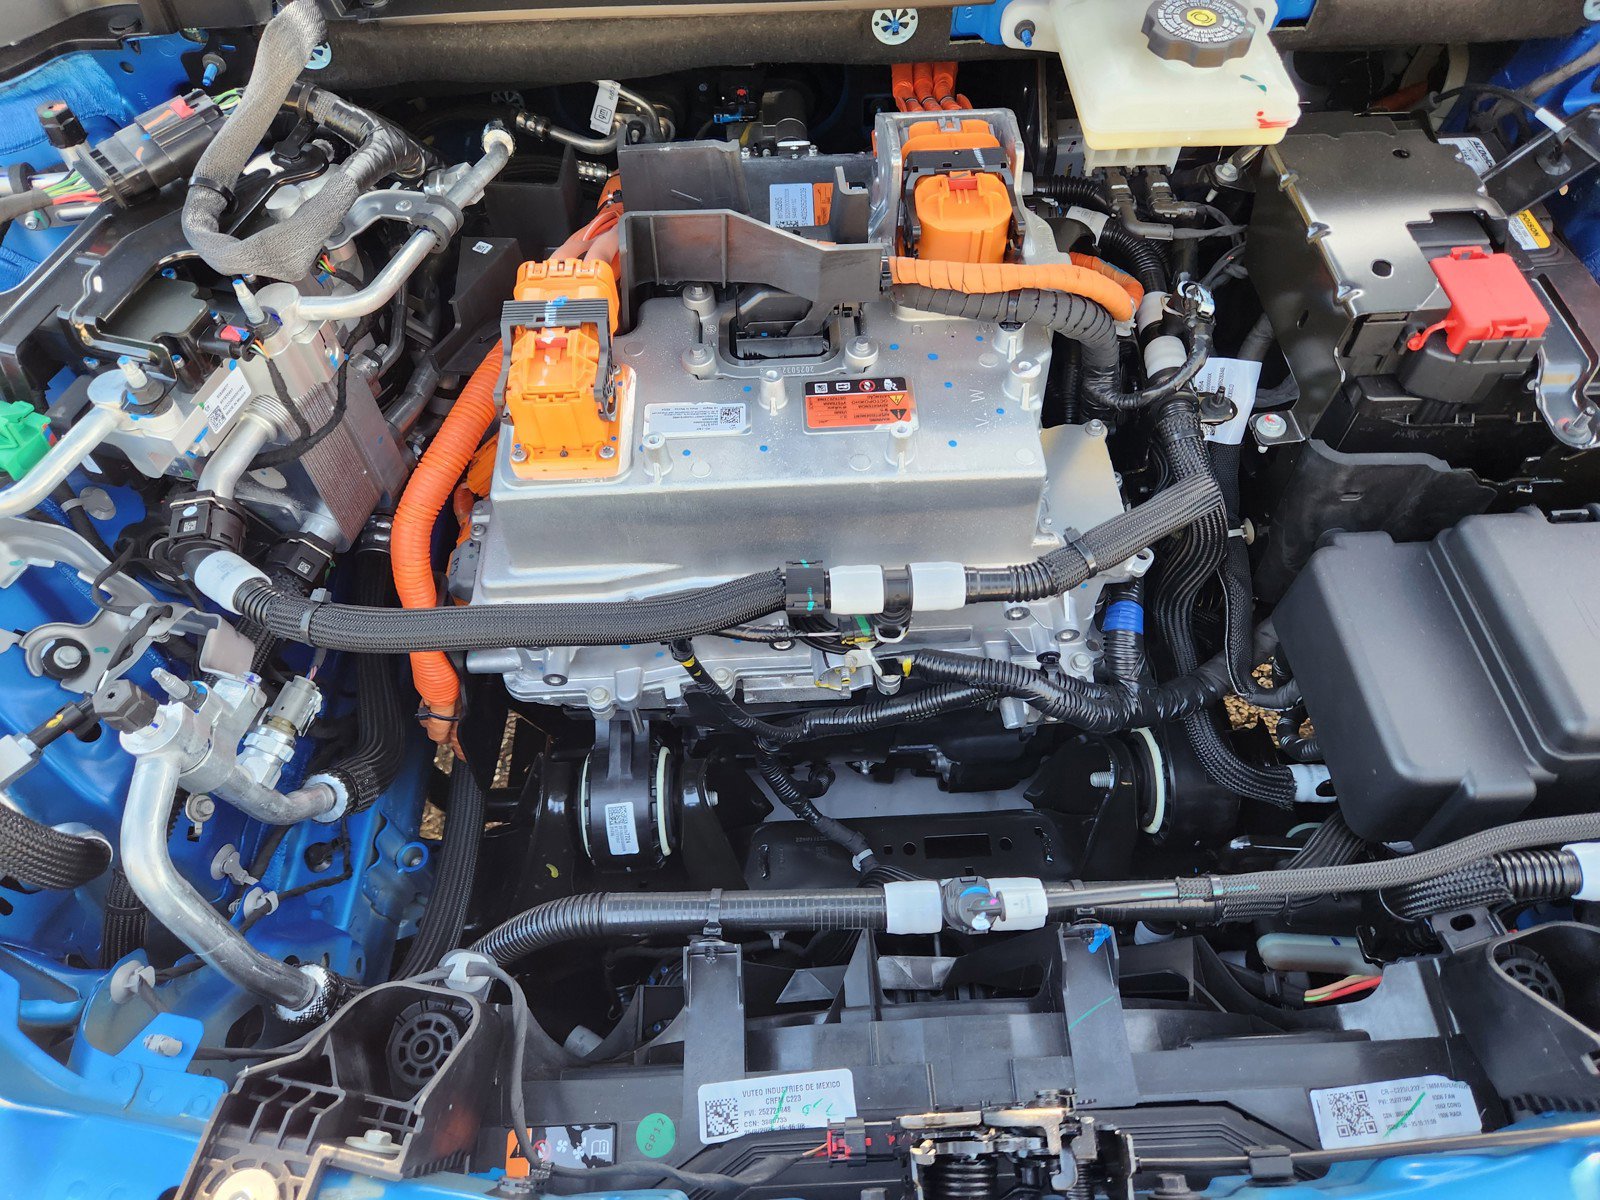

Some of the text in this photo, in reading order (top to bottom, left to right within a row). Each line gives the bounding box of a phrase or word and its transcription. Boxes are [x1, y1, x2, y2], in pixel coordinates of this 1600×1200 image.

[765, 1085, 804, 1095] INDUSTRIES
[805, 1083, 814, 1091] DE
[816, 1081, 841, 1090] MEXICO
[786, 1094, 802, 1103] C223
